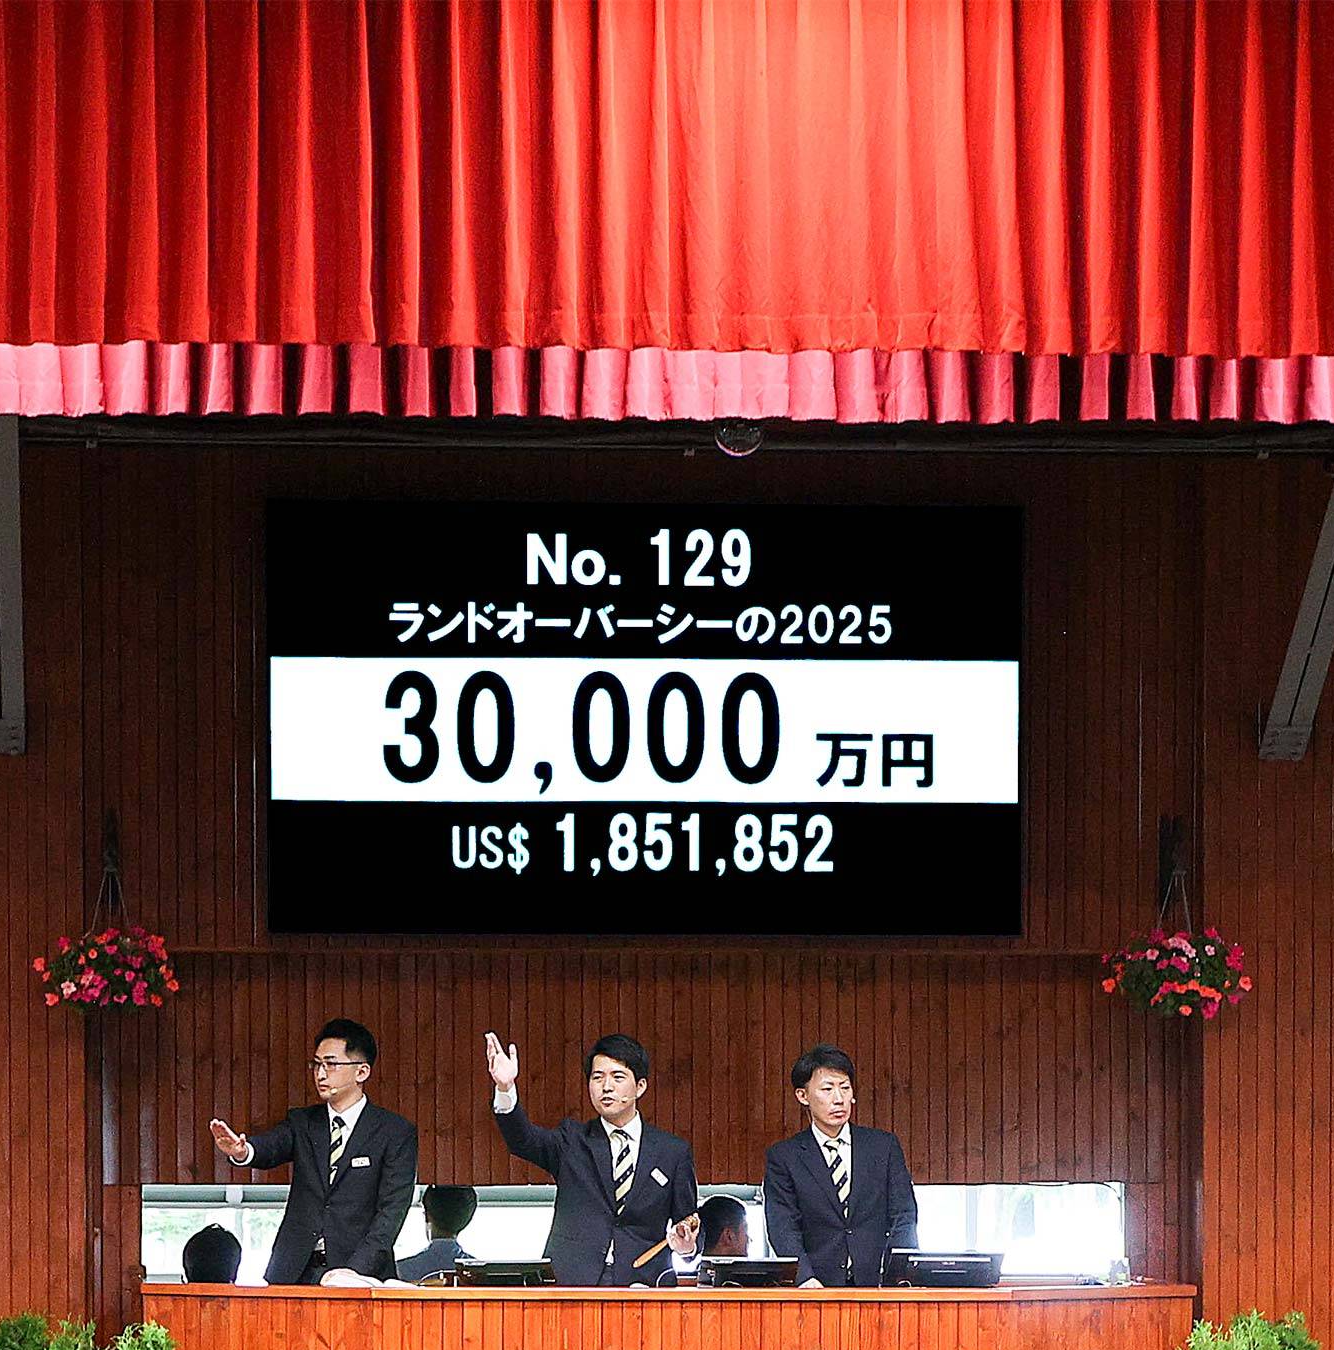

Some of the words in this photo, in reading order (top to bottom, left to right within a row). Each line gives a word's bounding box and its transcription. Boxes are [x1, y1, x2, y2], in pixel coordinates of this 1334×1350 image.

[526, 532, 621, 586] No.
[650, 528, 752, 588] 129
[388, 601, 892, 645] ランドオーバーシーの2025
[383, 670, 780, 795] 30,000
[816, 733, 935, 788] 万円
[451, 822, 530, 875] US$
[555, 812, 834, 877] 1,851,852
